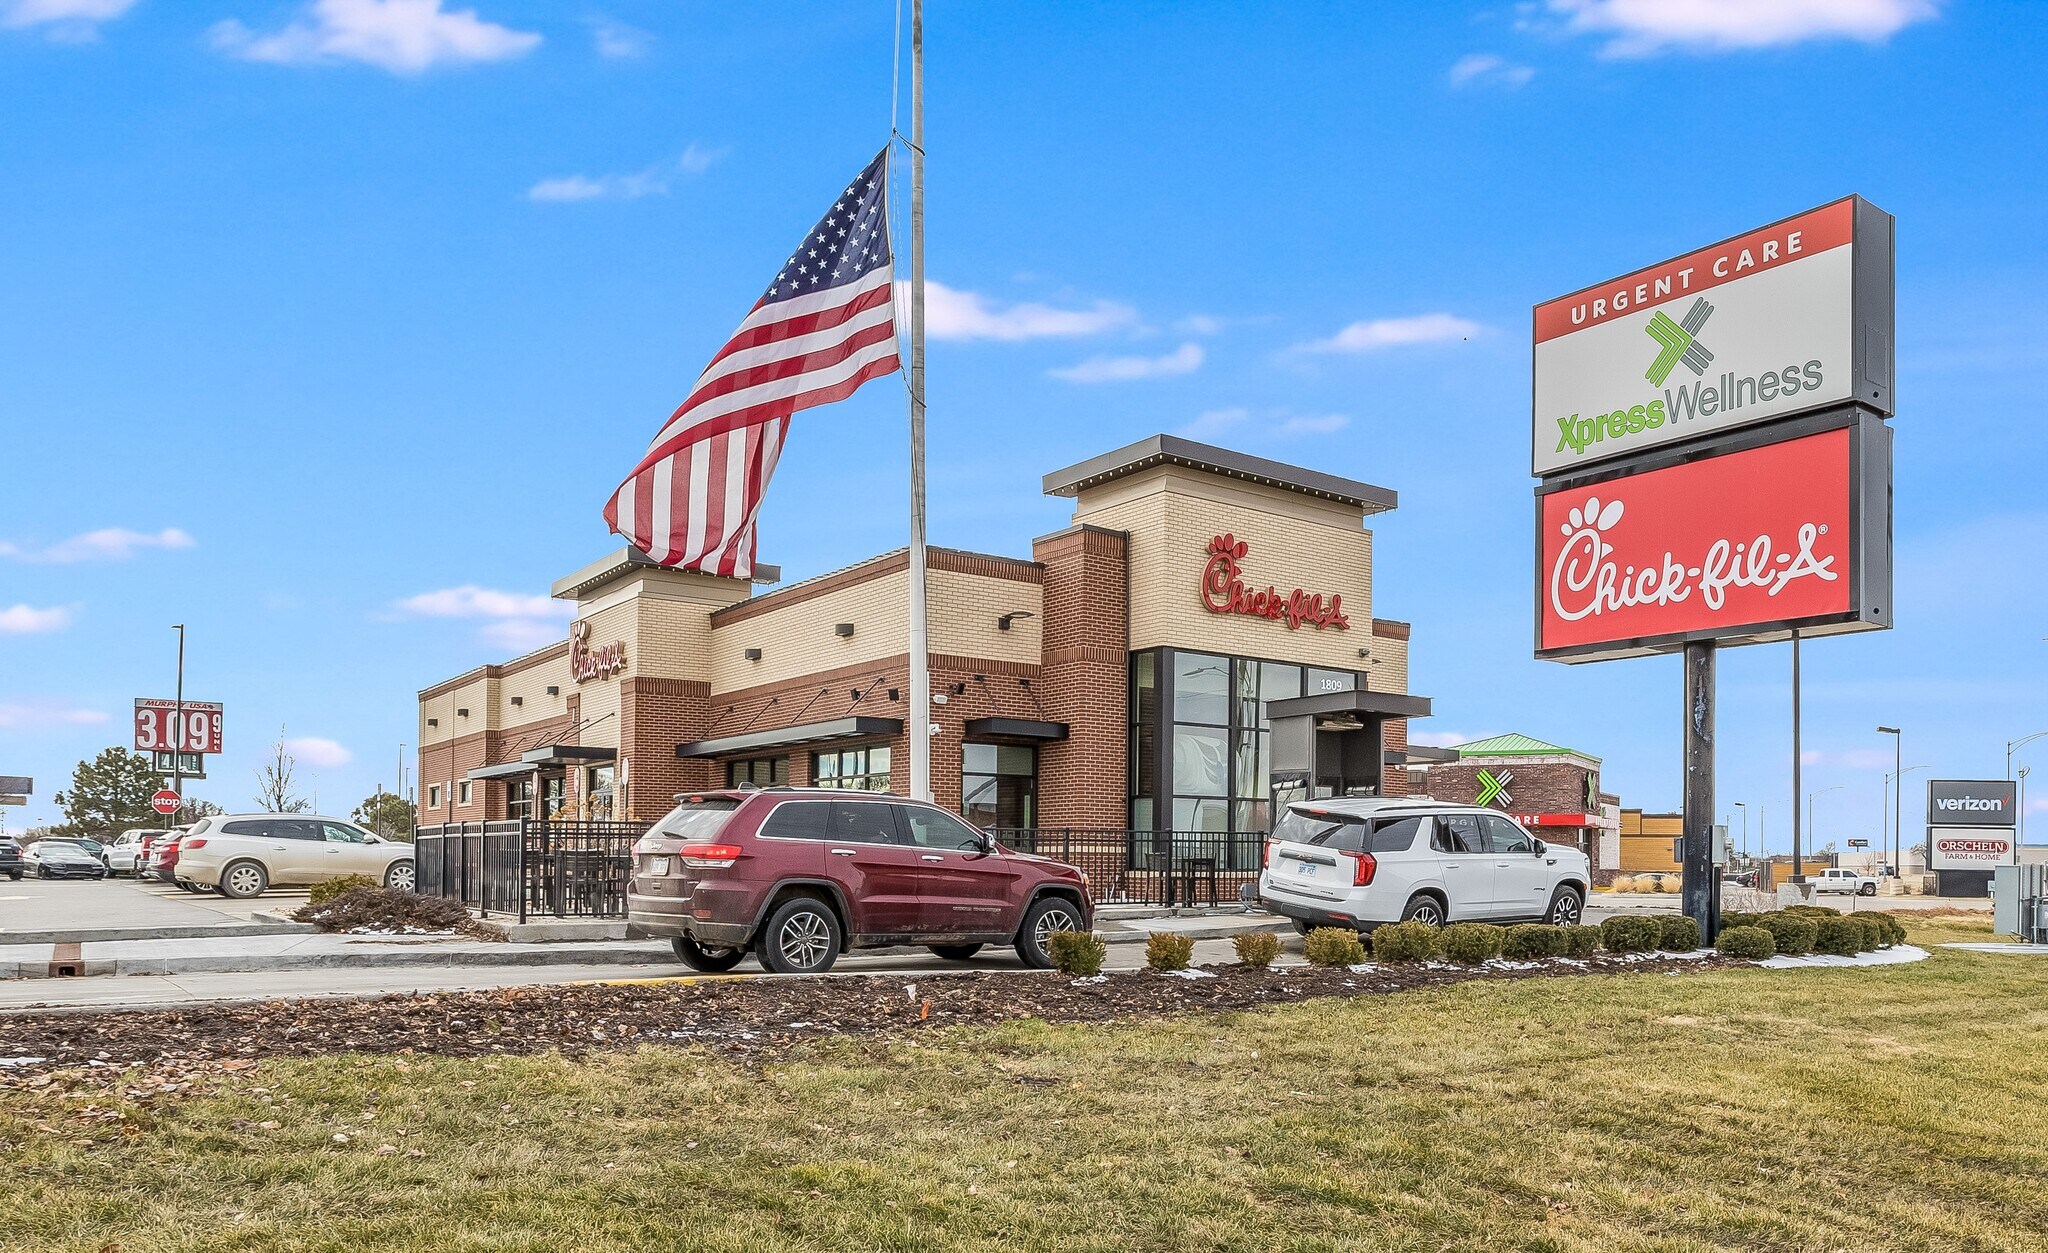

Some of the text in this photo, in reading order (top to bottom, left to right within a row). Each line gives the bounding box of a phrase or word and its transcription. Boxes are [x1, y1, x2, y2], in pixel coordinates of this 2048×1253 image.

[1570, 230, 1803, 326] URGENT CARE
[1555, 359, 1824, 455] XpressWellness
[1551, 519, 1838, 621] Chick-fil-A
[1201, 546, 1351, 630] Chick-fil-A
[1320, 678, 1343, 691] 1809
[154, 797, 180, 808] stop
[1936, 795, 2003, 811] verizon
[1440, 816, 1496, 828] URGT
[1939, 841, 2005, 853] ORSCHELN
